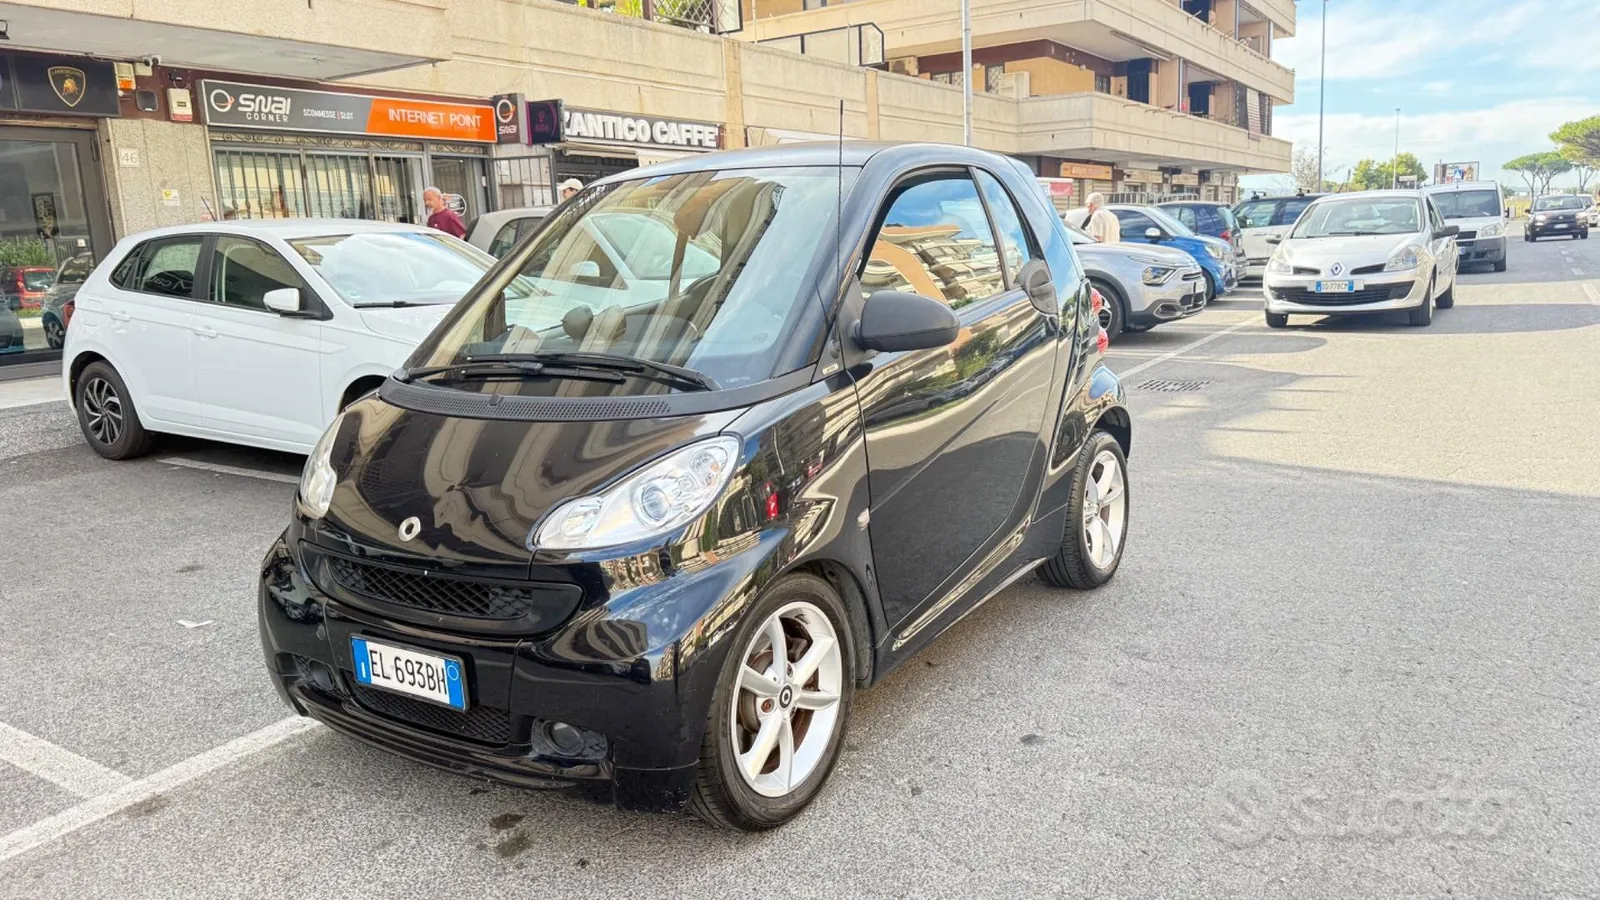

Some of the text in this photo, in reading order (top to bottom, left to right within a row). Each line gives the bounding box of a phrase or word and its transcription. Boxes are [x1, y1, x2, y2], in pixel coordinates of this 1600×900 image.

[246, 112, 289, 123] CORNER
[303, 108, 337, 119] SCOMMESSE
[388, 108, 482, 128] INTERNET POINT
[121, 152, 138, 164] 46
[369, 650, 391, 680] EL
[393, 656, 448, 696] 693BH
